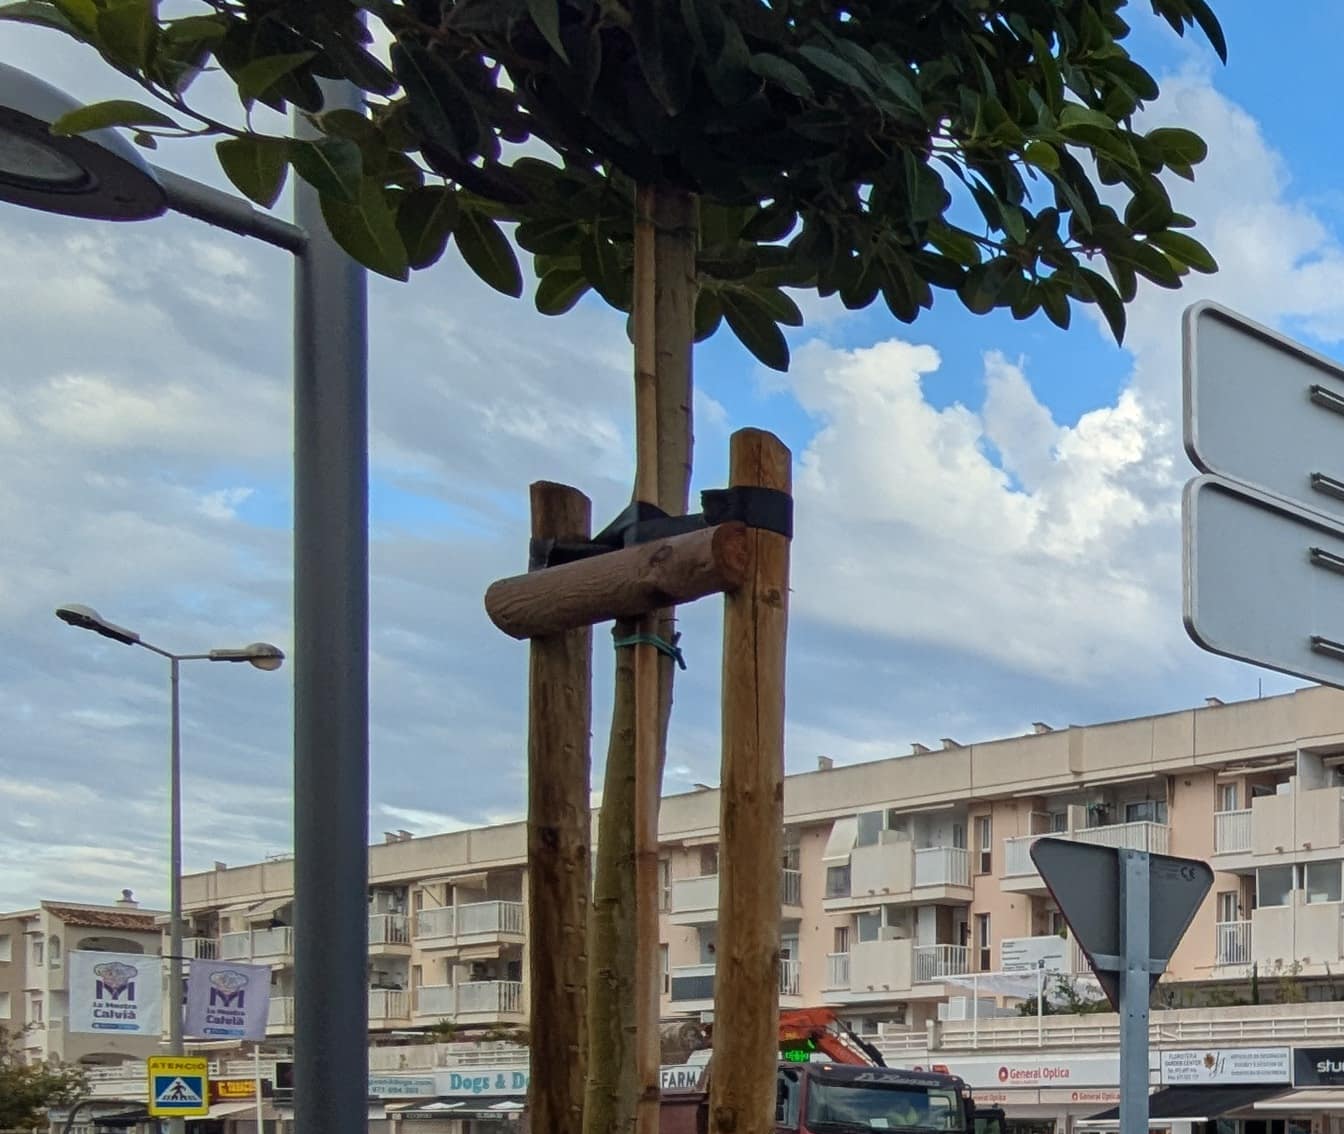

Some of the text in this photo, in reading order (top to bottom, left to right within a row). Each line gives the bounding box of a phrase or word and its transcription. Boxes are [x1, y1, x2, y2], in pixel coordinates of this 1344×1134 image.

[93, 1008, 136, 1020] Calvià
[206, 1015, 244, 1026] Calvià
[661, 1072, 696, 1089] FARM
[1010, 1068, 1070, 1081] General Optica
[450, 1072, 490, 1094] Dogs
[495, 1073, 505, 1089] &
[512, 1072, 529, 1090] D
[1079, 1092, 1100, 1101] General
